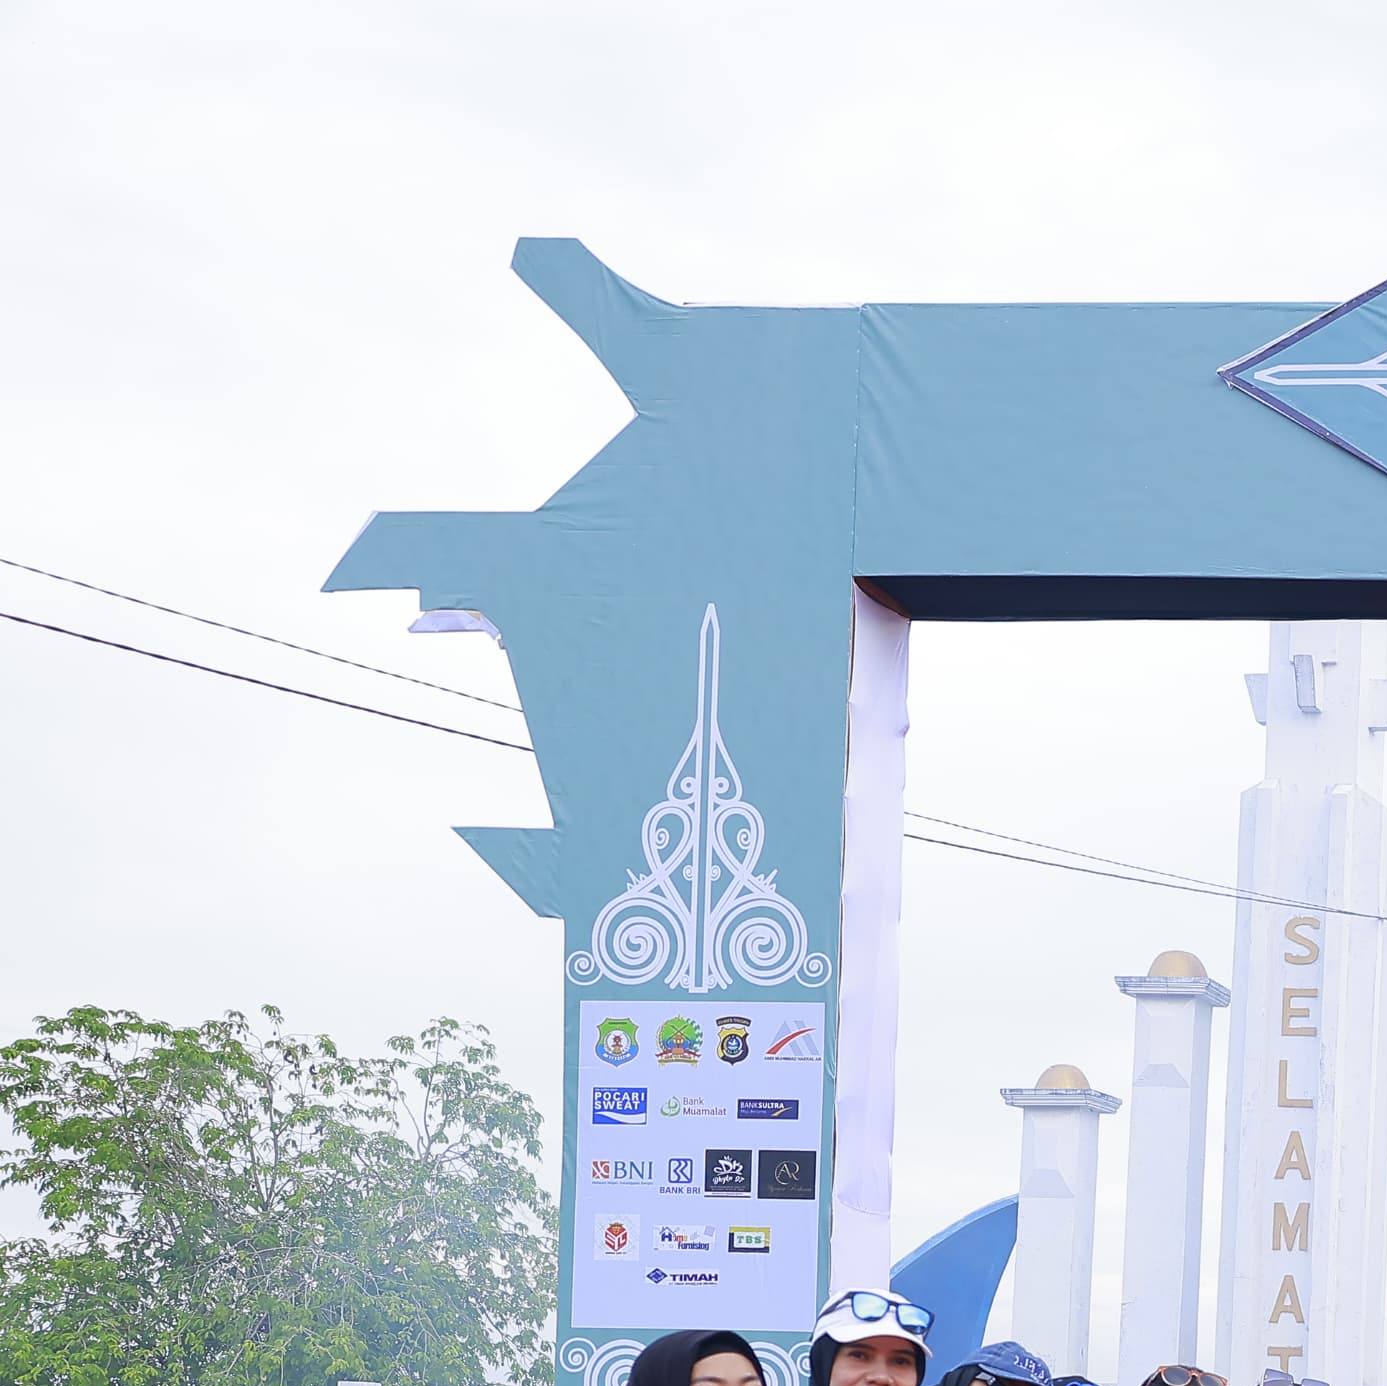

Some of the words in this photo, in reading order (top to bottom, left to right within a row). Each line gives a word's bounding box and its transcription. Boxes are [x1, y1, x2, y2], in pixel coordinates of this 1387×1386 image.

[594, 1091, 645, 1101] POCARI
[594, 1101, 641, 1110] SWEAT
[683, 1097, 705, 1106] Bank
[683, 1107, 727, 1116] Muamalat
[1267, 915, 1321, 1374] SELAMAT
[614, 1161, 653, 1180] BNI
[686, 1187, 701, 1195] BRI
[736, 1235, 763, 1244] TBS
[669, 1273, 719, 1282] TIMAH
